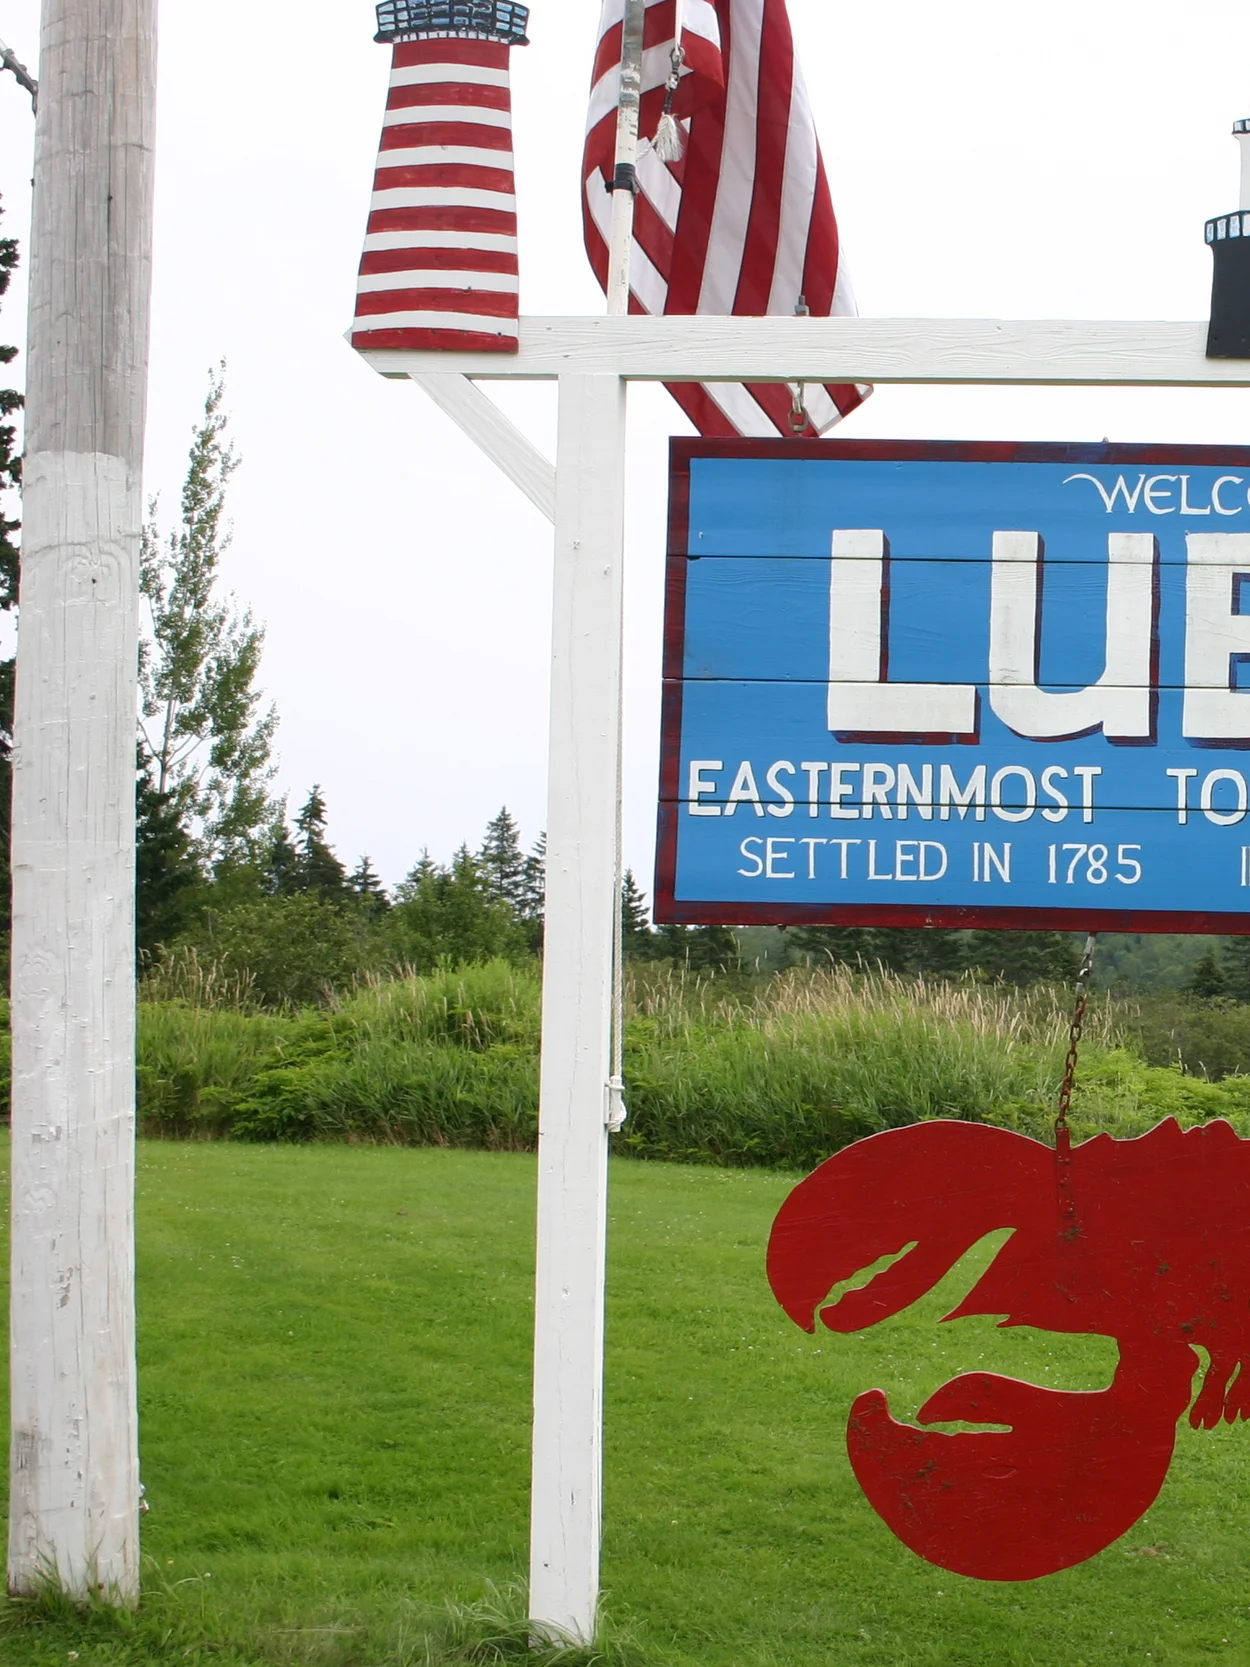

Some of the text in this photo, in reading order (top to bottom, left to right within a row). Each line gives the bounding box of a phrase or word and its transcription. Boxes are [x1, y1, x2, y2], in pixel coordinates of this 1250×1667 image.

[688, 760, 1102, 823] EASTERNMOST
[737, 836, 948, 881] SETTLED
[973, 842, 1011, 883] IN
[1048, 843, 1142, 884] 1785
